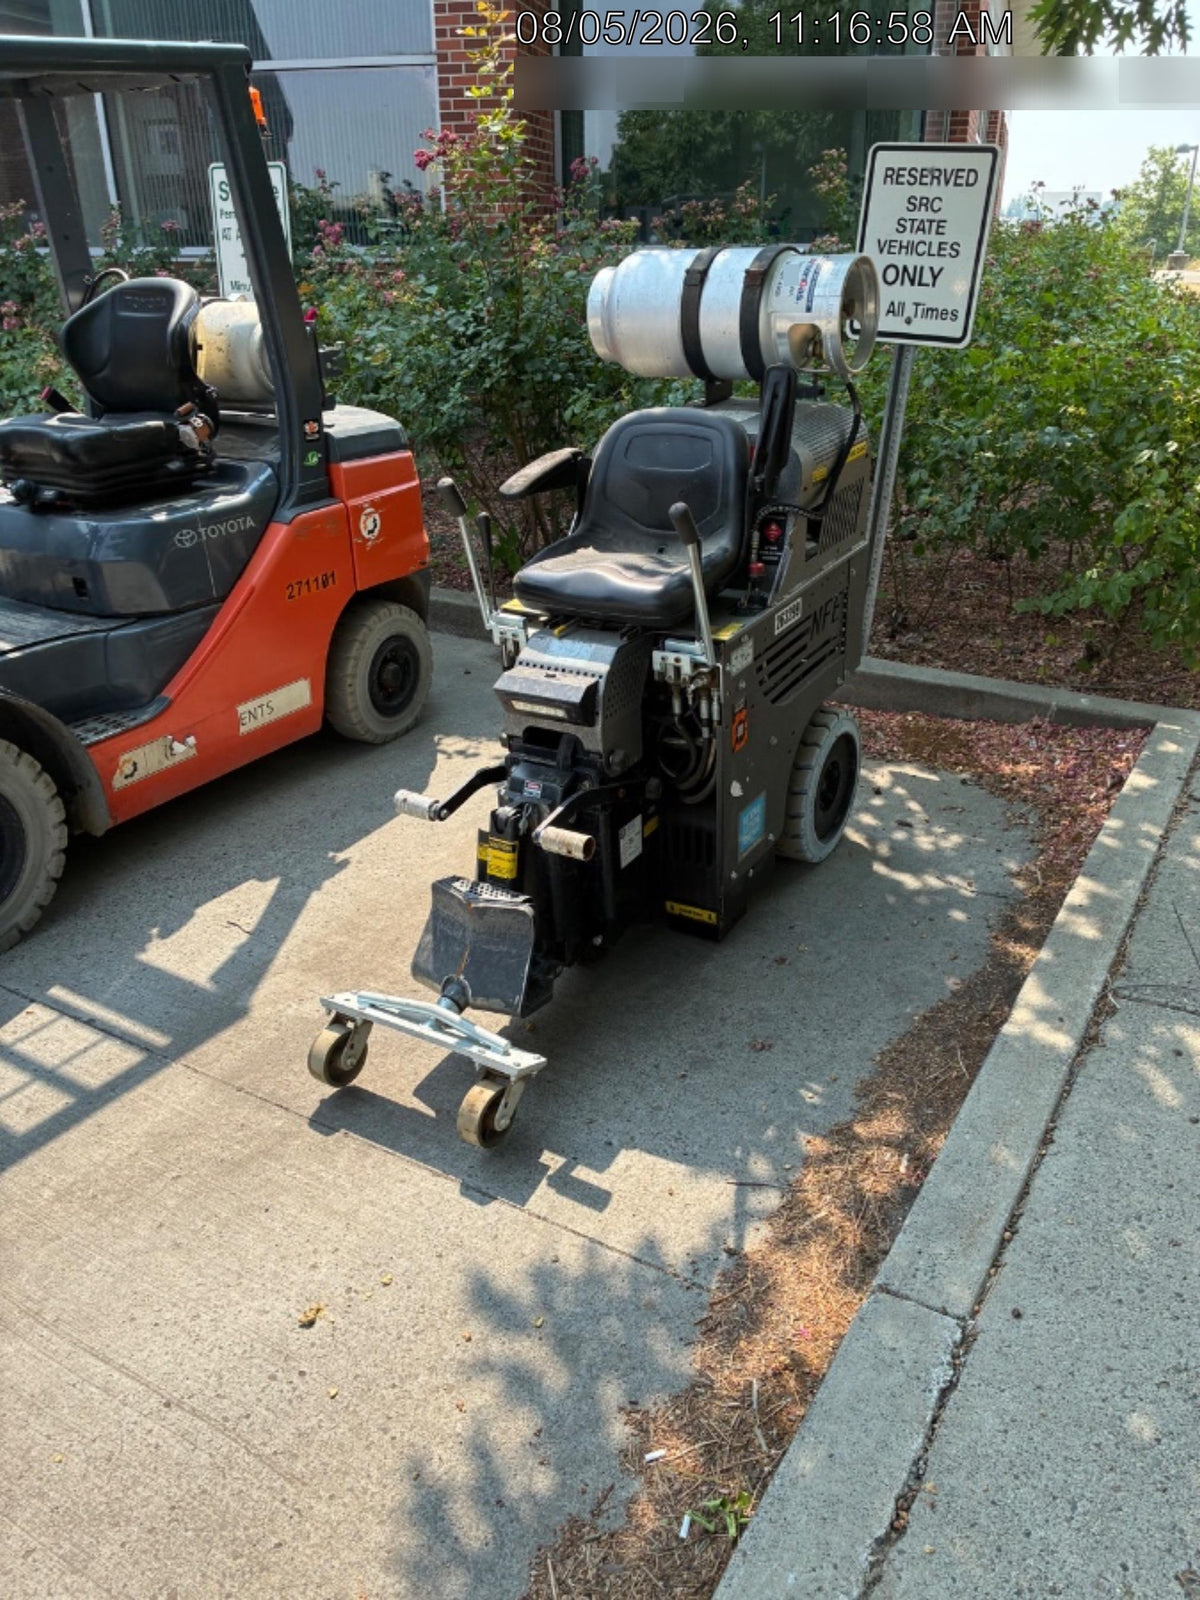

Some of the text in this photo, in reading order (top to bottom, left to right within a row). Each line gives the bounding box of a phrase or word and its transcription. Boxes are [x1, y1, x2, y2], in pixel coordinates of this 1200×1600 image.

[883, 166, 979, 188] RESERVED
[906, 195, 943, 213] SRC
[895, 217, 947, 236] STATE
[877, 239, 961, 259] VEHICLES
[882, 263, 945, 288] ONLY
[885, 301, 959, 322] All Times
[198, 515, 257, 541] TOYOTA
[285, 569, 337, 601] 271101
[239, 699, 275, 727] ENTS
